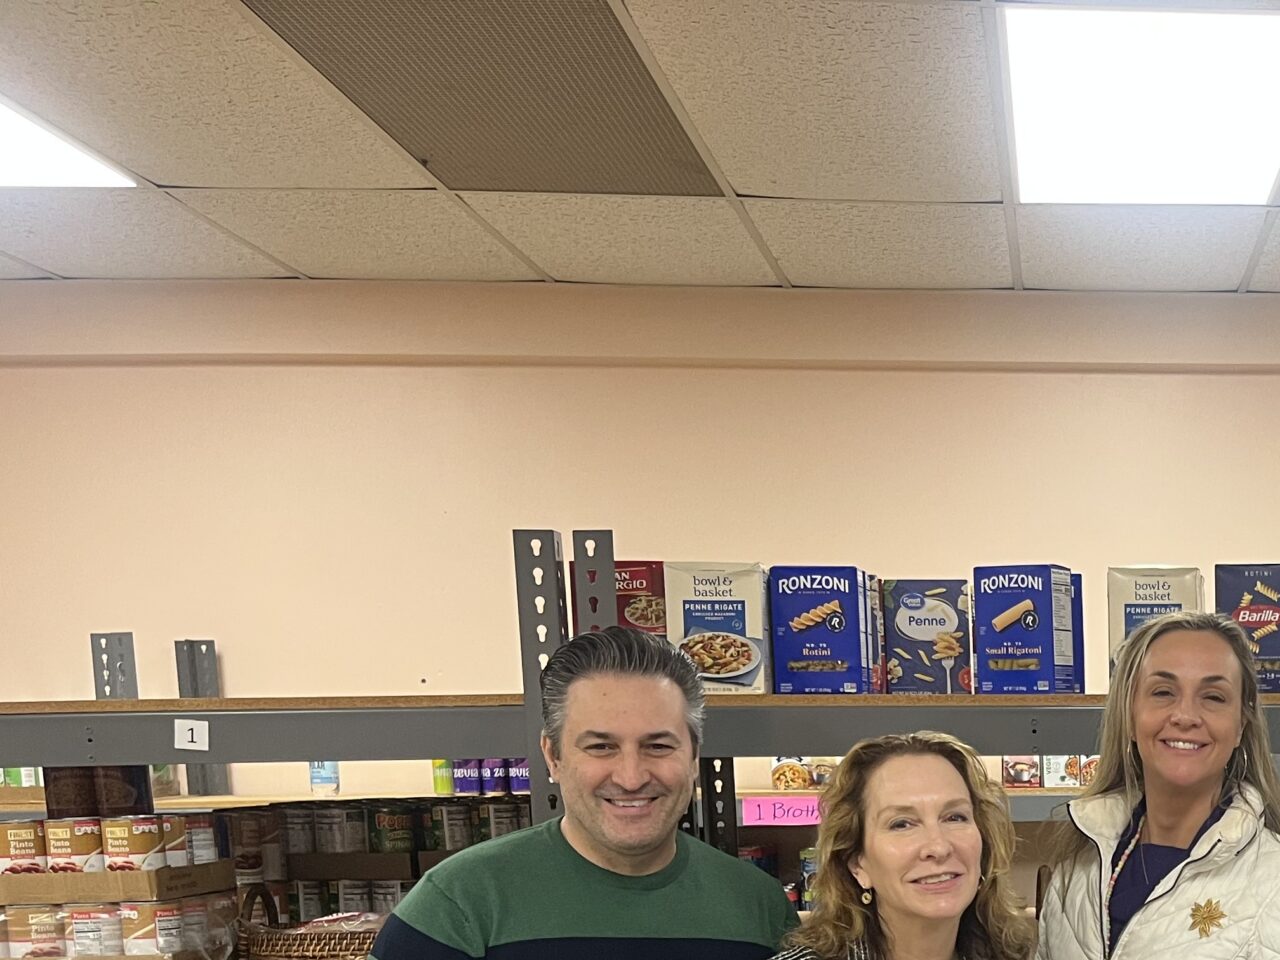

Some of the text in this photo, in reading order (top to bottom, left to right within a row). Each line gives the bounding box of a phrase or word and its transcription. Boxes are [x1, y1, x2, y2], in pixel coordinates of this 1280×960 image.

[614, 572, 630, 580] AN
[693, 576, 720, 586] bowl
[616, 580, 646, 590] RGIO
[778, 575, 849, 594] RONZONI
[981, 574, 1042, 593] RONZONI
[1135, 580, 1160, 591] bowl
[694, 586, 733, 597] basket
[1135, 591, 1171, 601] basket
[909, 616, 946, 626] Penne
[1239, 610, 1280, 622] Barilla
[802, 648, 830, 656] Rotini
[986, 646, 1042, 656] Small Rigatoni
[187, 728, 197, 743] 1
[453, 768, 478, 778] zevia
[509, 768, 529, 776] evia
[755, 802, 820, 820] 1 Broth
